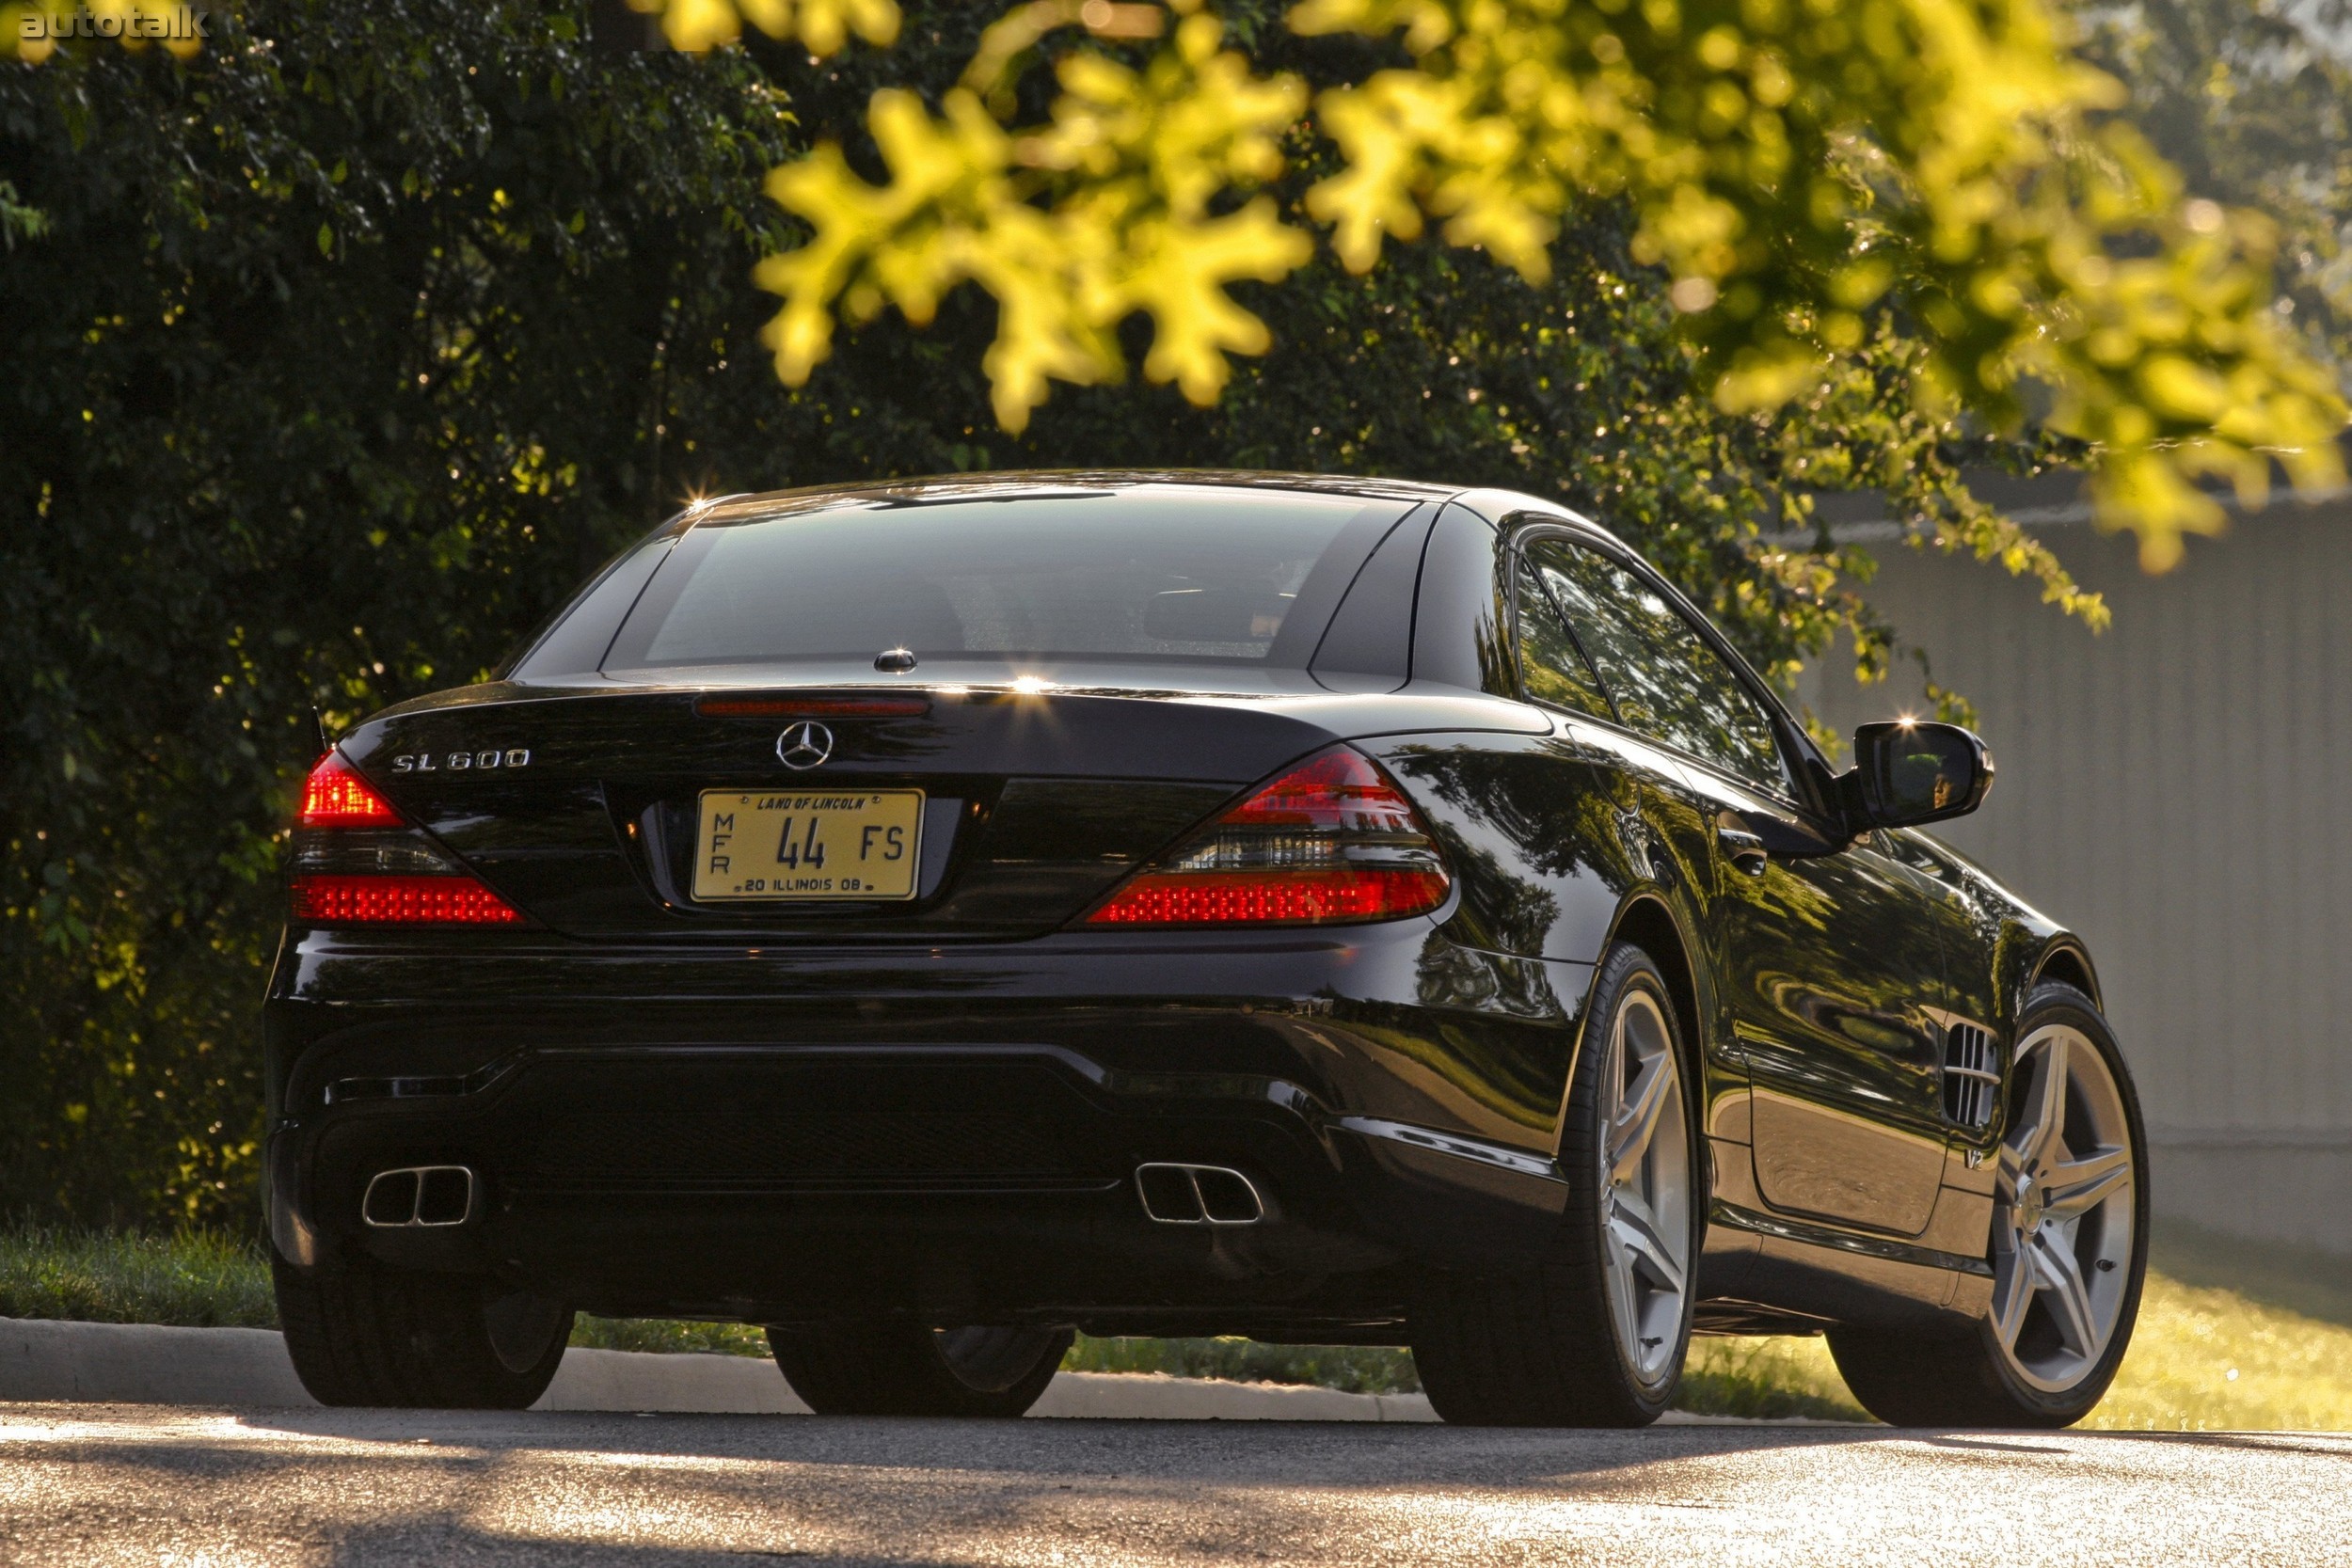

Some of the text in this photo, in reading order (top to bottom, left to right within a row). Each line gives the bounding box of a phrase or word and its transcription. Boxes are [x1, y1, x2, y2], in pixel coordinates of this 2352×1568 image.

[391, 749, 530, 773] SL 600
[757, 798, 865, 810] LAND OF LINCOLN
[776, 816, 903, 869] 44 FS
[745, 879, 861, 892] 20 ILLINOIS 08
